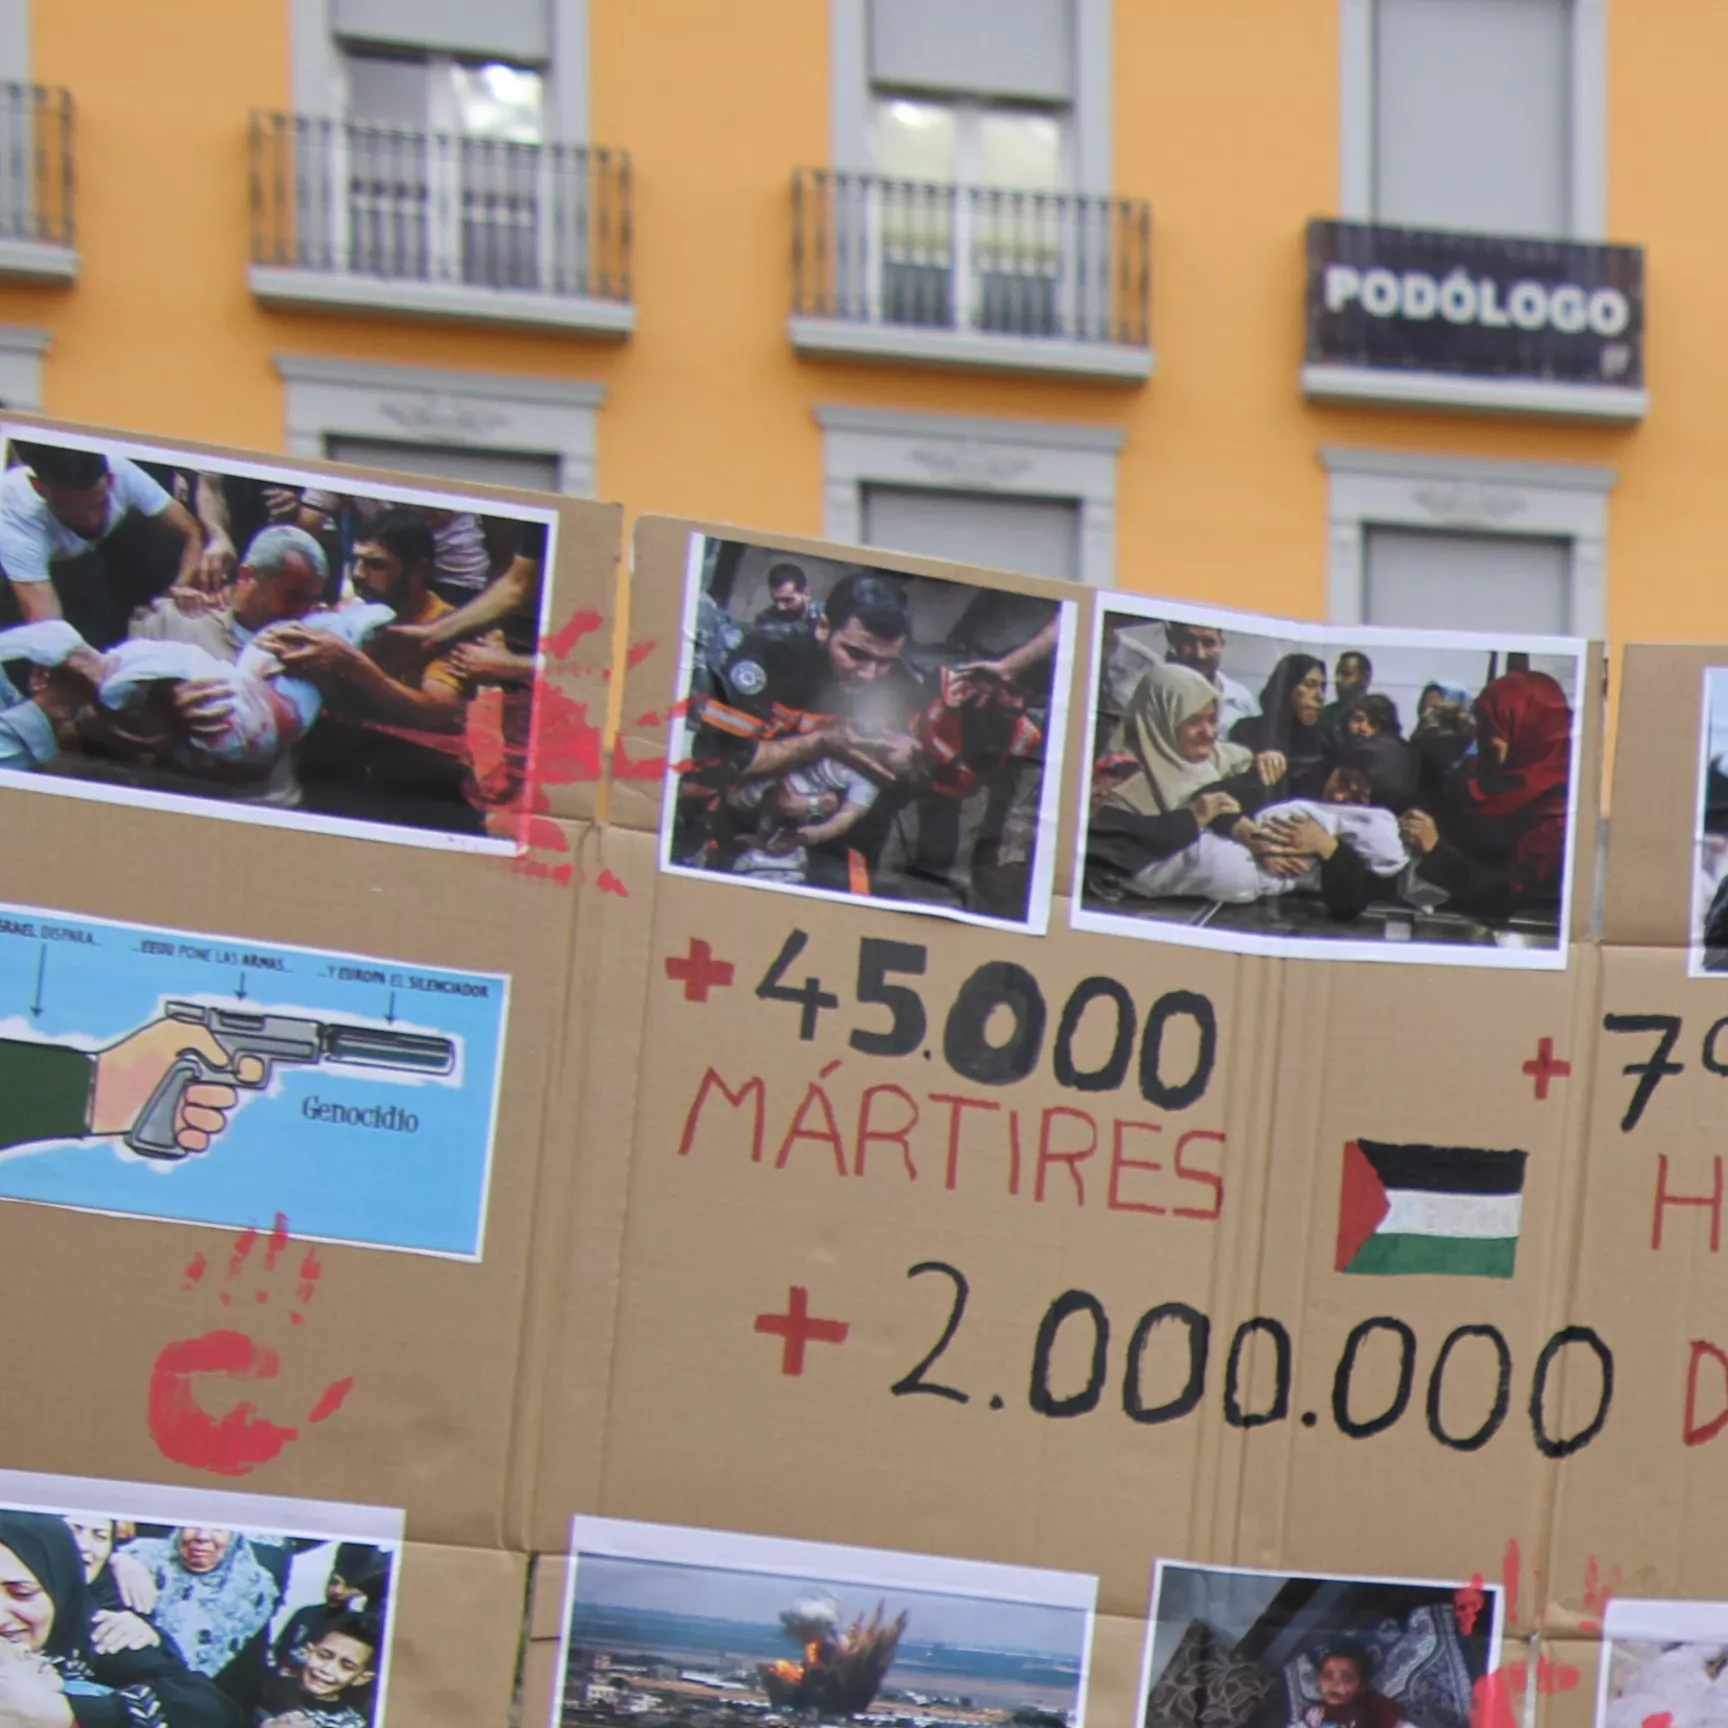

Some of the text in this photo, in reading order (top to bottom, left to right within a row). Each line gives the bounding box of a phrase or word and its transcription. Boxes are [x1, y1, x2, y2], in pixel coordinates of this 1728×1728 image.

[1325, 265, 1629, 337] PODÓLOGO
[178, 943, 212, 963] PONE
[215, 949, 239, 965] LAS
[337, 966, 387, 985] EUROPA
[302, 1095, 420, 1133] Genocidio
[678, 1059, 1226, 1221] MÁRTIRES
